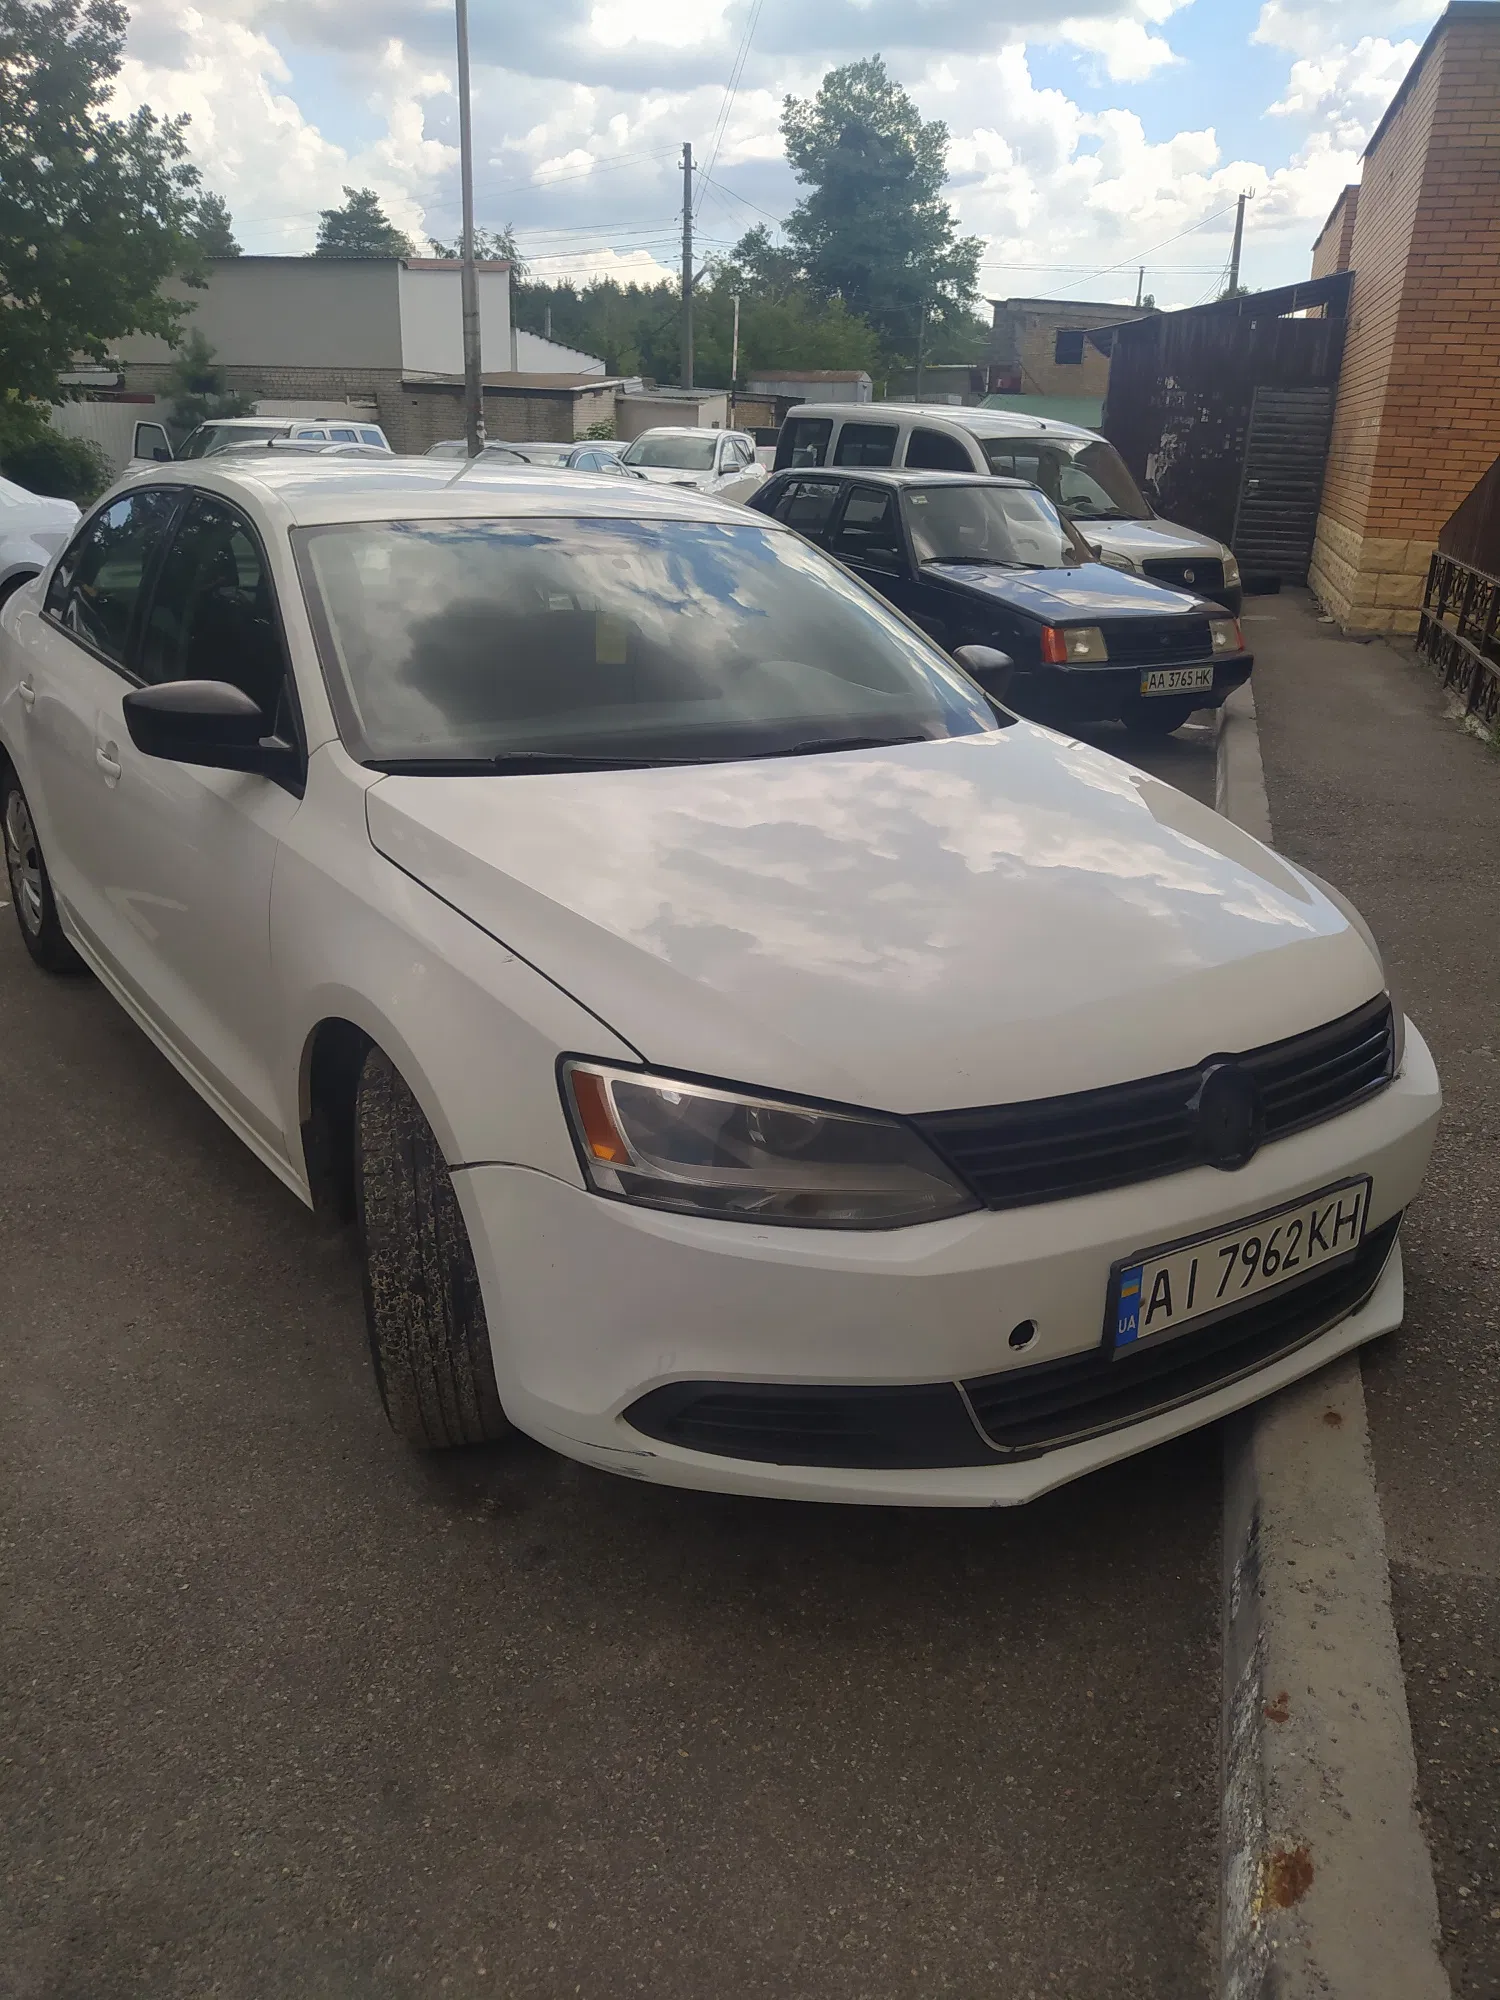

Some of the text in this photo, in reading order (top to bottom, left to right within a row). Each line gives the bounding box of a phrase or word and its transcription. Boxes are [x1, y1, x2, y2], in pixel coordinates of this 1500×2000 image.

[1148, 673, 1165, 689] AA
[1168, 671, 1193, 688] 3765
[1118, 1315, 1136, 1334] UA
